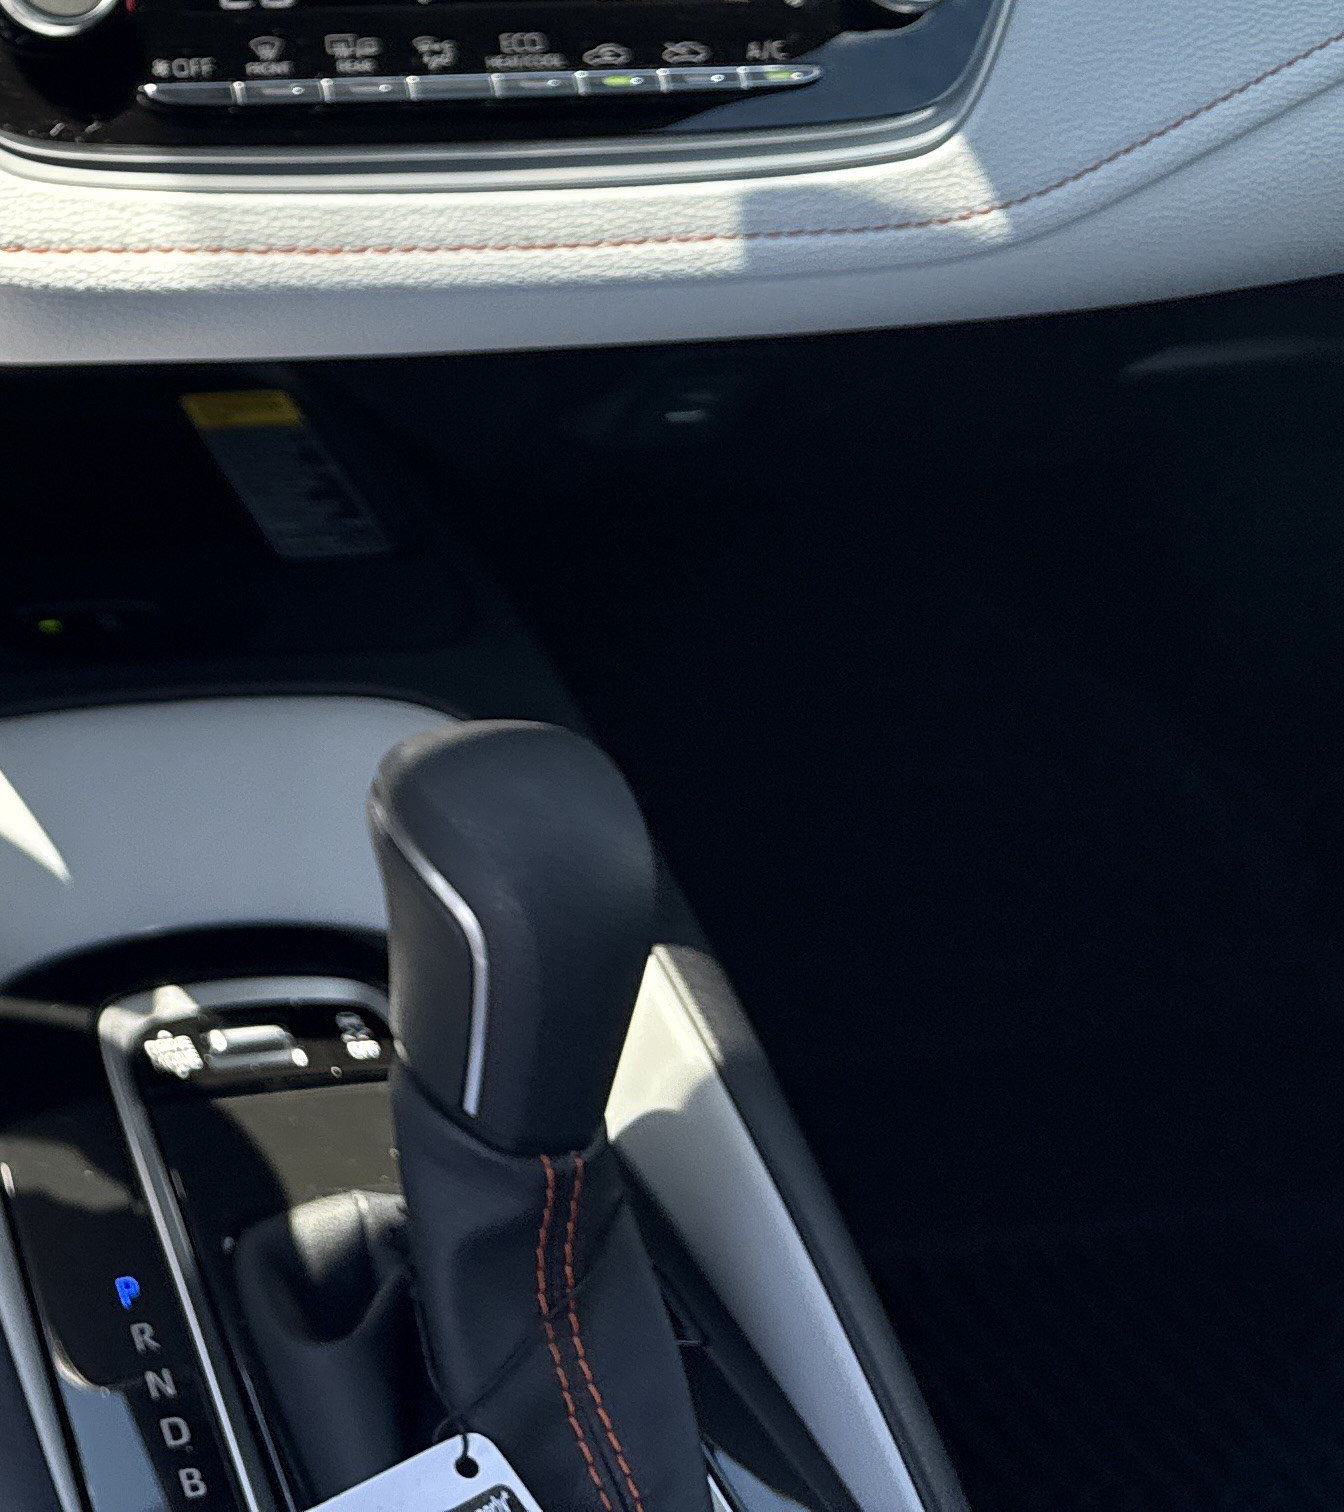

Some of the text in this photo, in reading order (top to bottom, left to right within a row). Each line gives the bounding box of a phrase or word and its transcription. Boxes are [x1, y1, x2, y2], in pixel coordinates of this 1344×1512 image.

[114, 1275, 141, 1310] P
[129, 1321, 161, 1353] R
[143, 1367, 178, 1400] N
[159, 1416, 191, 1451] D
[178, 1466, 207, 1500] B
